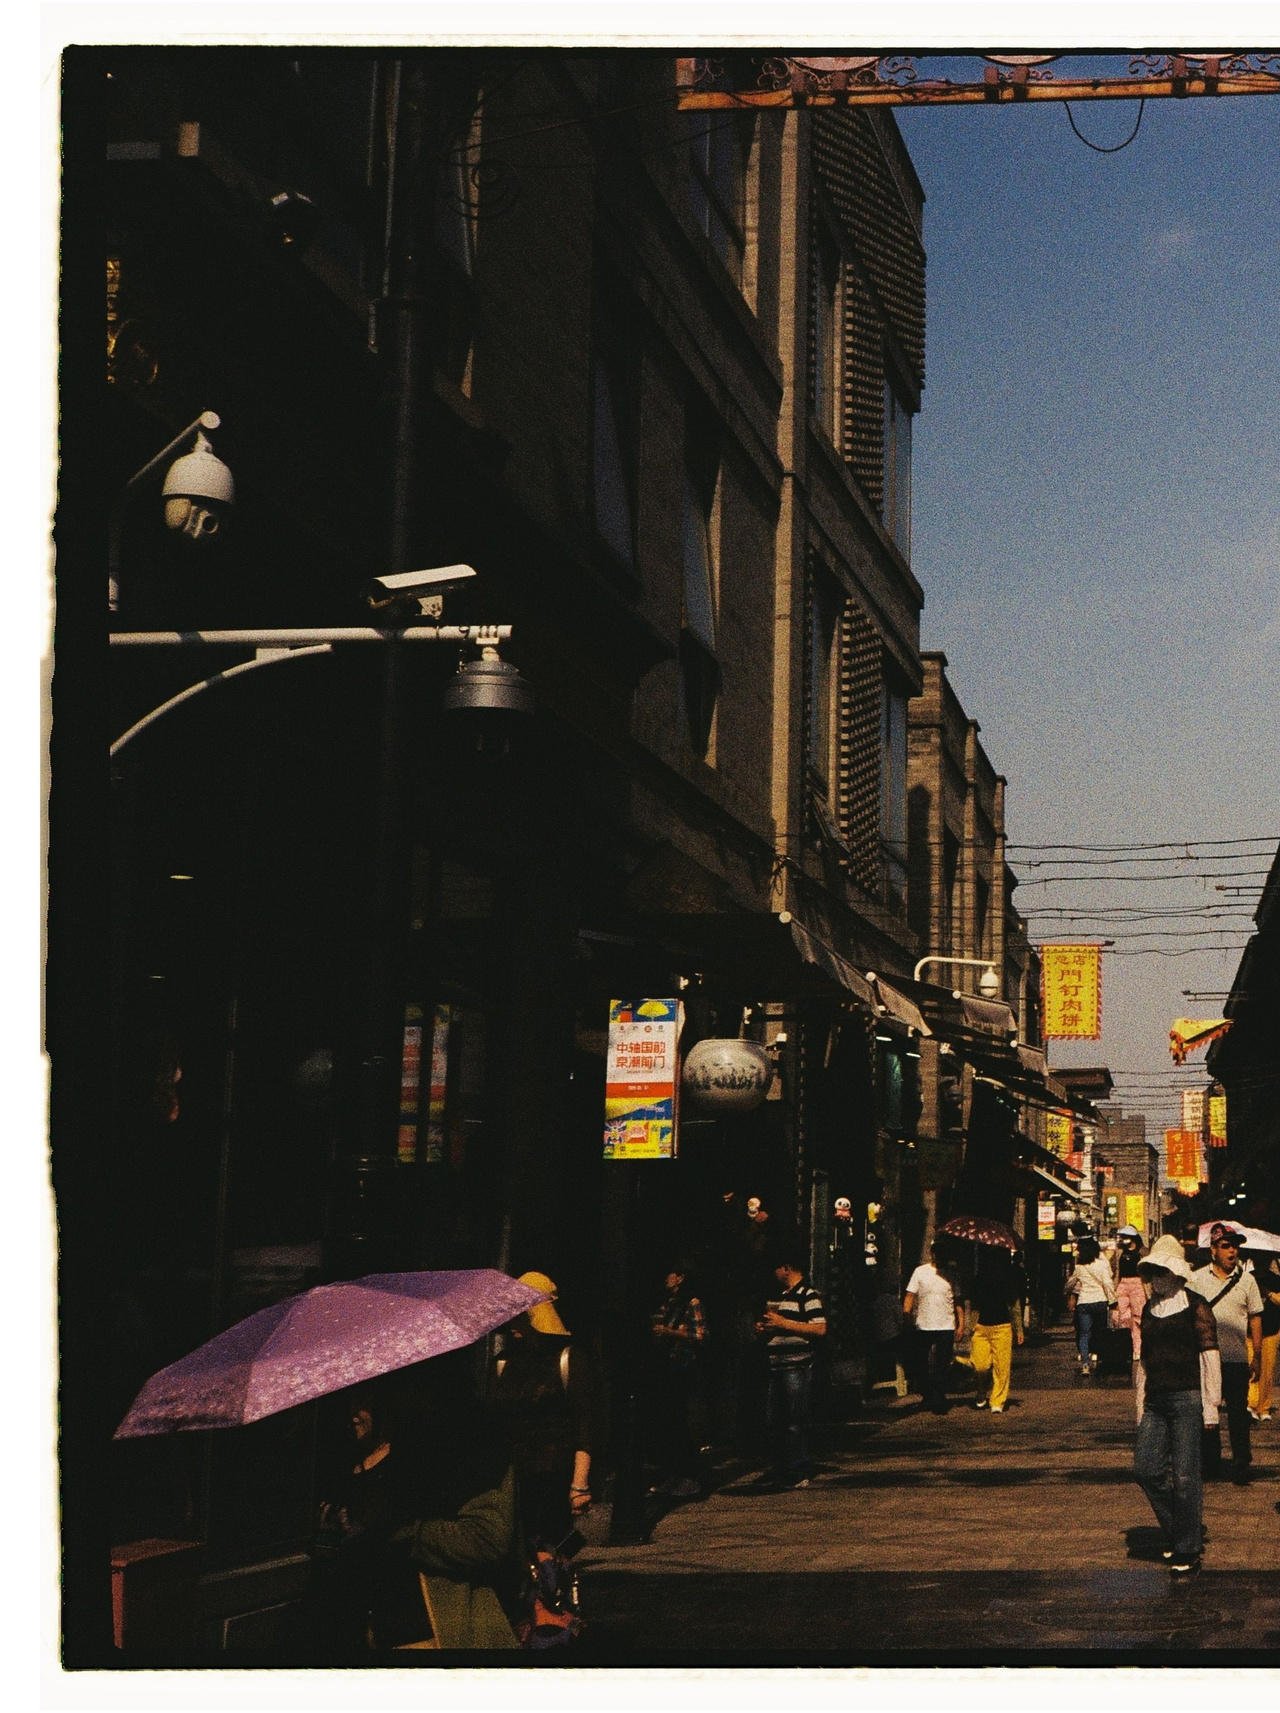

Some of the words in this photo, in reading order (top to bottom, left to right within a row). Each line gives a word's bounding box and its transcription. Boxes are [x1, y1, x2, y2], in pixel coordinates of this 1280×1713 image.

[616, 1041, 666, 1055] 中轴国韵
[616, 1056, 665, 1069] 京潮前门
